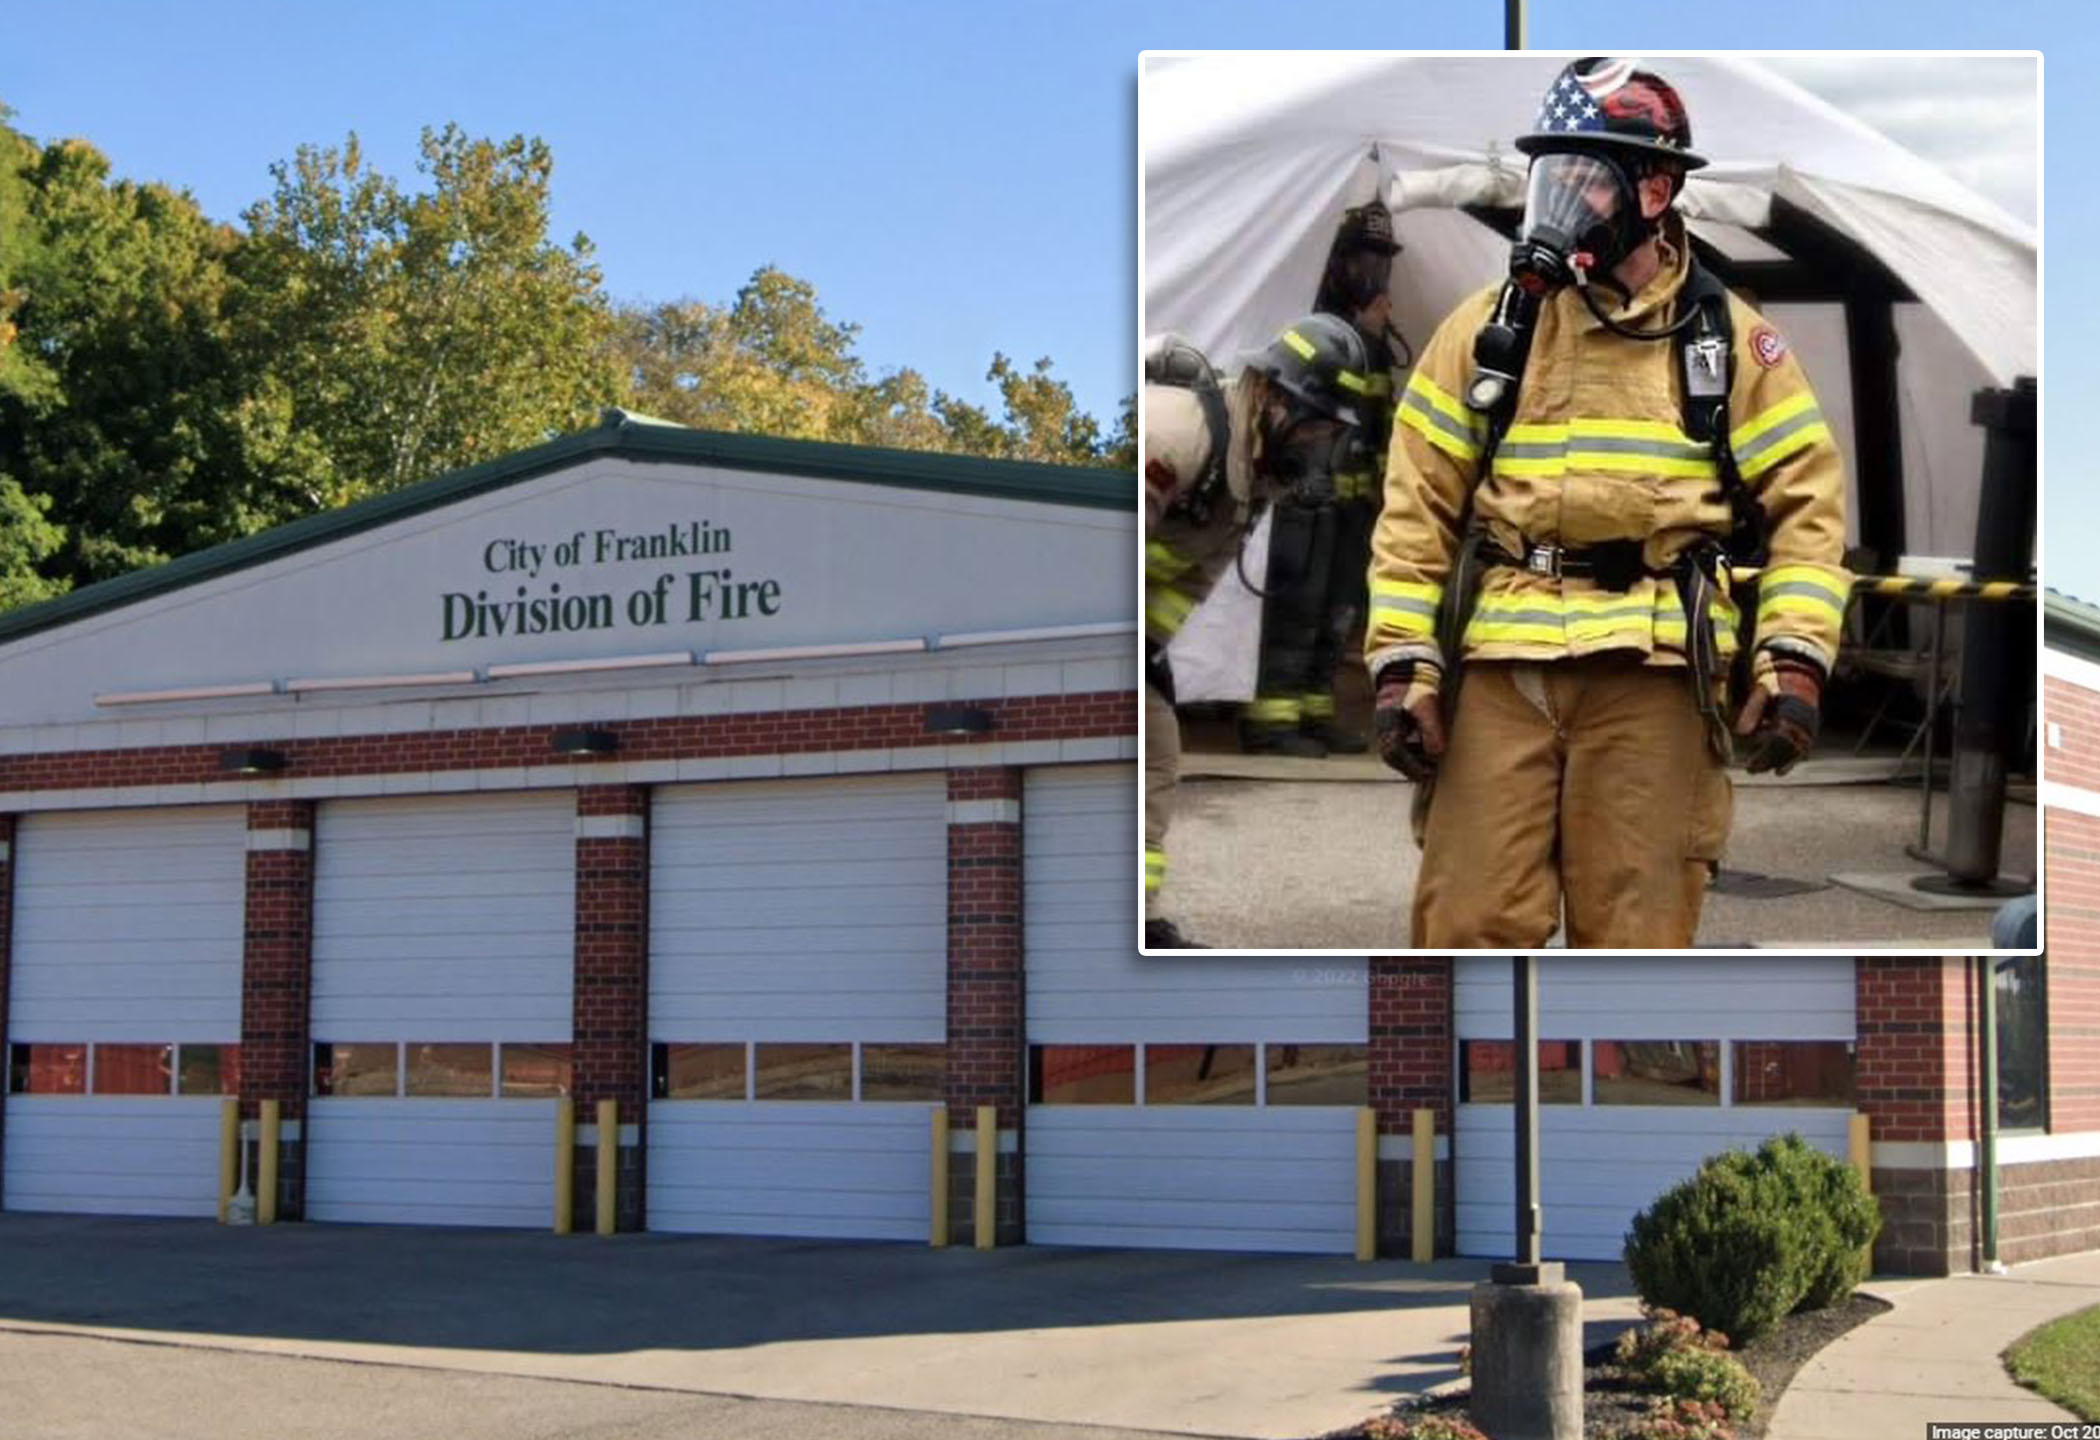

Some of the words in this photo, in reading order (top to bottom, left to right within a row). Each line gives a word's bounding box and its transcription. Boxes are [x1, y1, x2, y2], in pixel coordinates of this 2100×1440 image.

[483, 539, 547, 578] City
[554, 532, 585, 567] of
[594, 520, 732, 564] Franklin
[439, 583, 614, 641] Division
[627, 574, 675, 627] of
[685, 569, 781, 623] Fire
